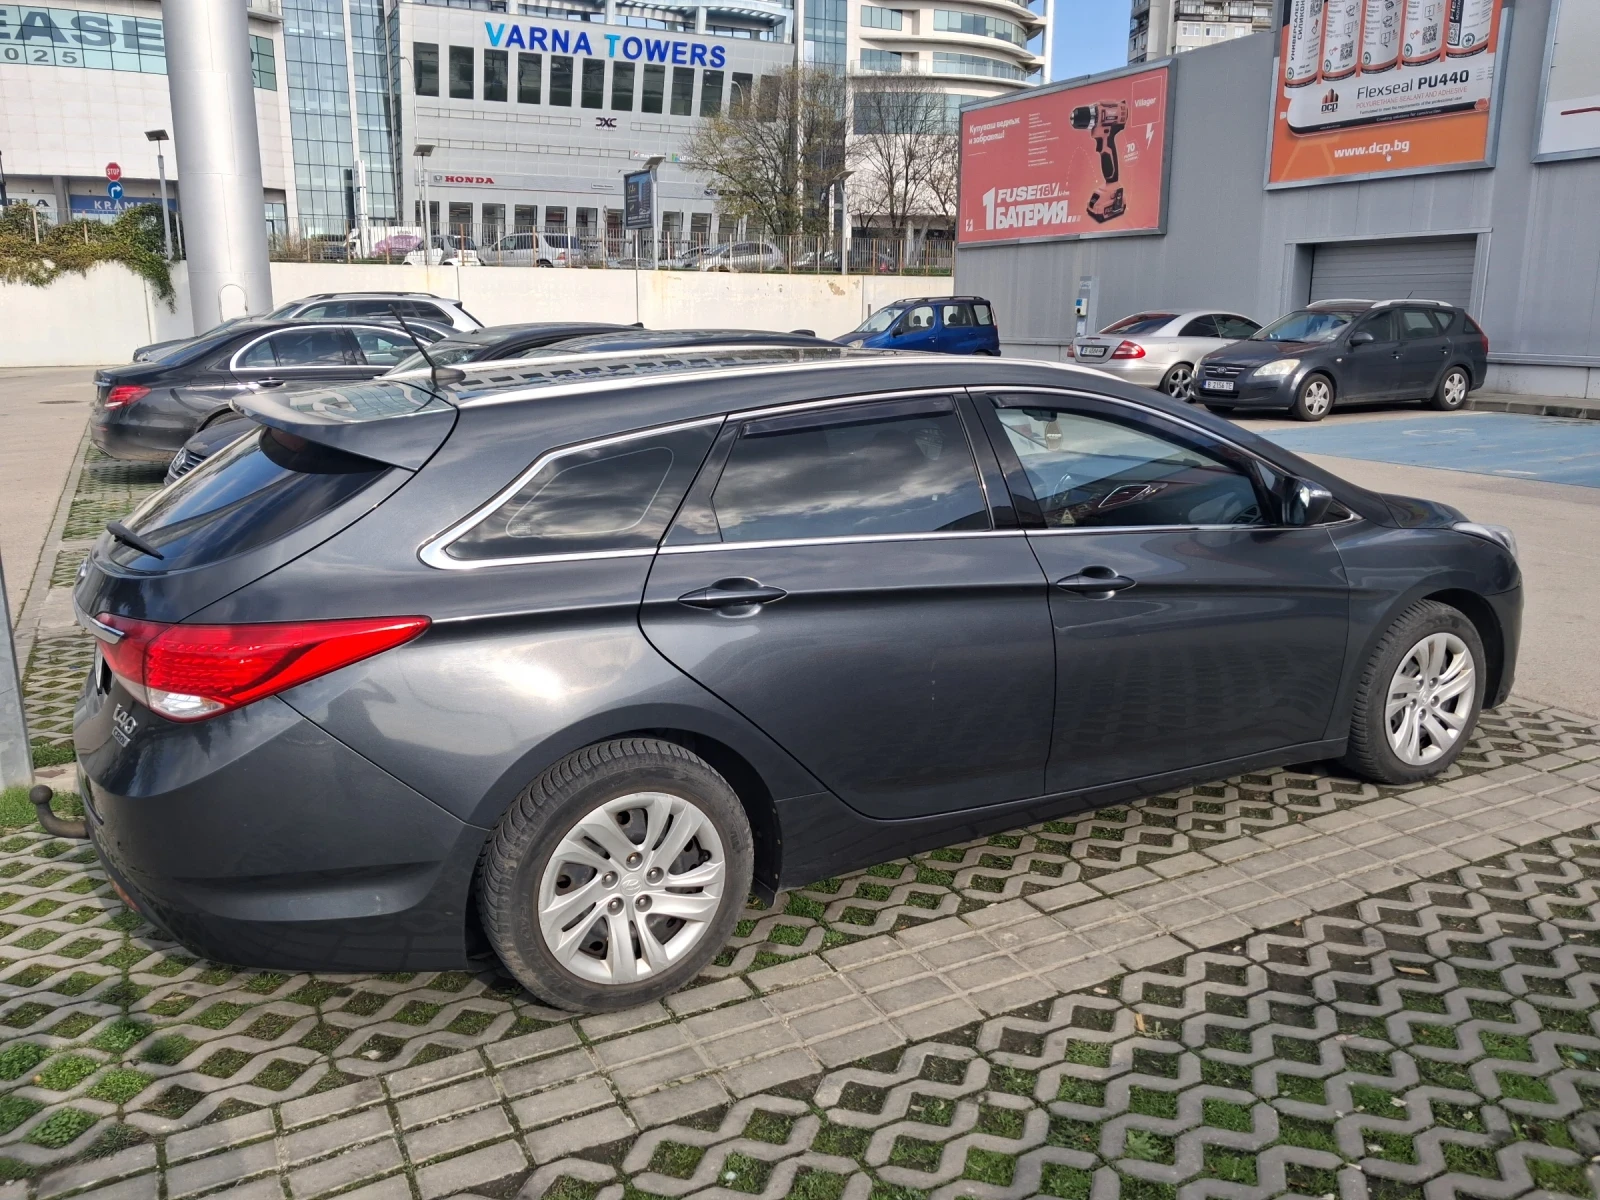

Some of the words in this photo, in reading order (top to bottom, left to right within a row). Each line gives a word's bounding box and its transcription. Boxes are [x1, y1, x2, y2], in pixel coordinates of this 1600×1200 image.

[0, 10, 165, 52] ASE
[484, 21, 592, 55] VARNA
[604, 33, 726, 68] TOWERS
[1356, 78, 1413, 99] Flexseal
[1418, 69, 1469, 89] PU440
[1356, 96, 1398, 108] POLYURETHANE
[1400, 92, 1424, 103] SEALANT
[1438, 86, 1467, 96] ADHESIVE
[1134, 97, 1156, 107] Villager
[1334, 139, 1410, 158] www.dcp.bg
[445, 176, 494, 184] HONDA
[983, 187, 995, 230] 1
